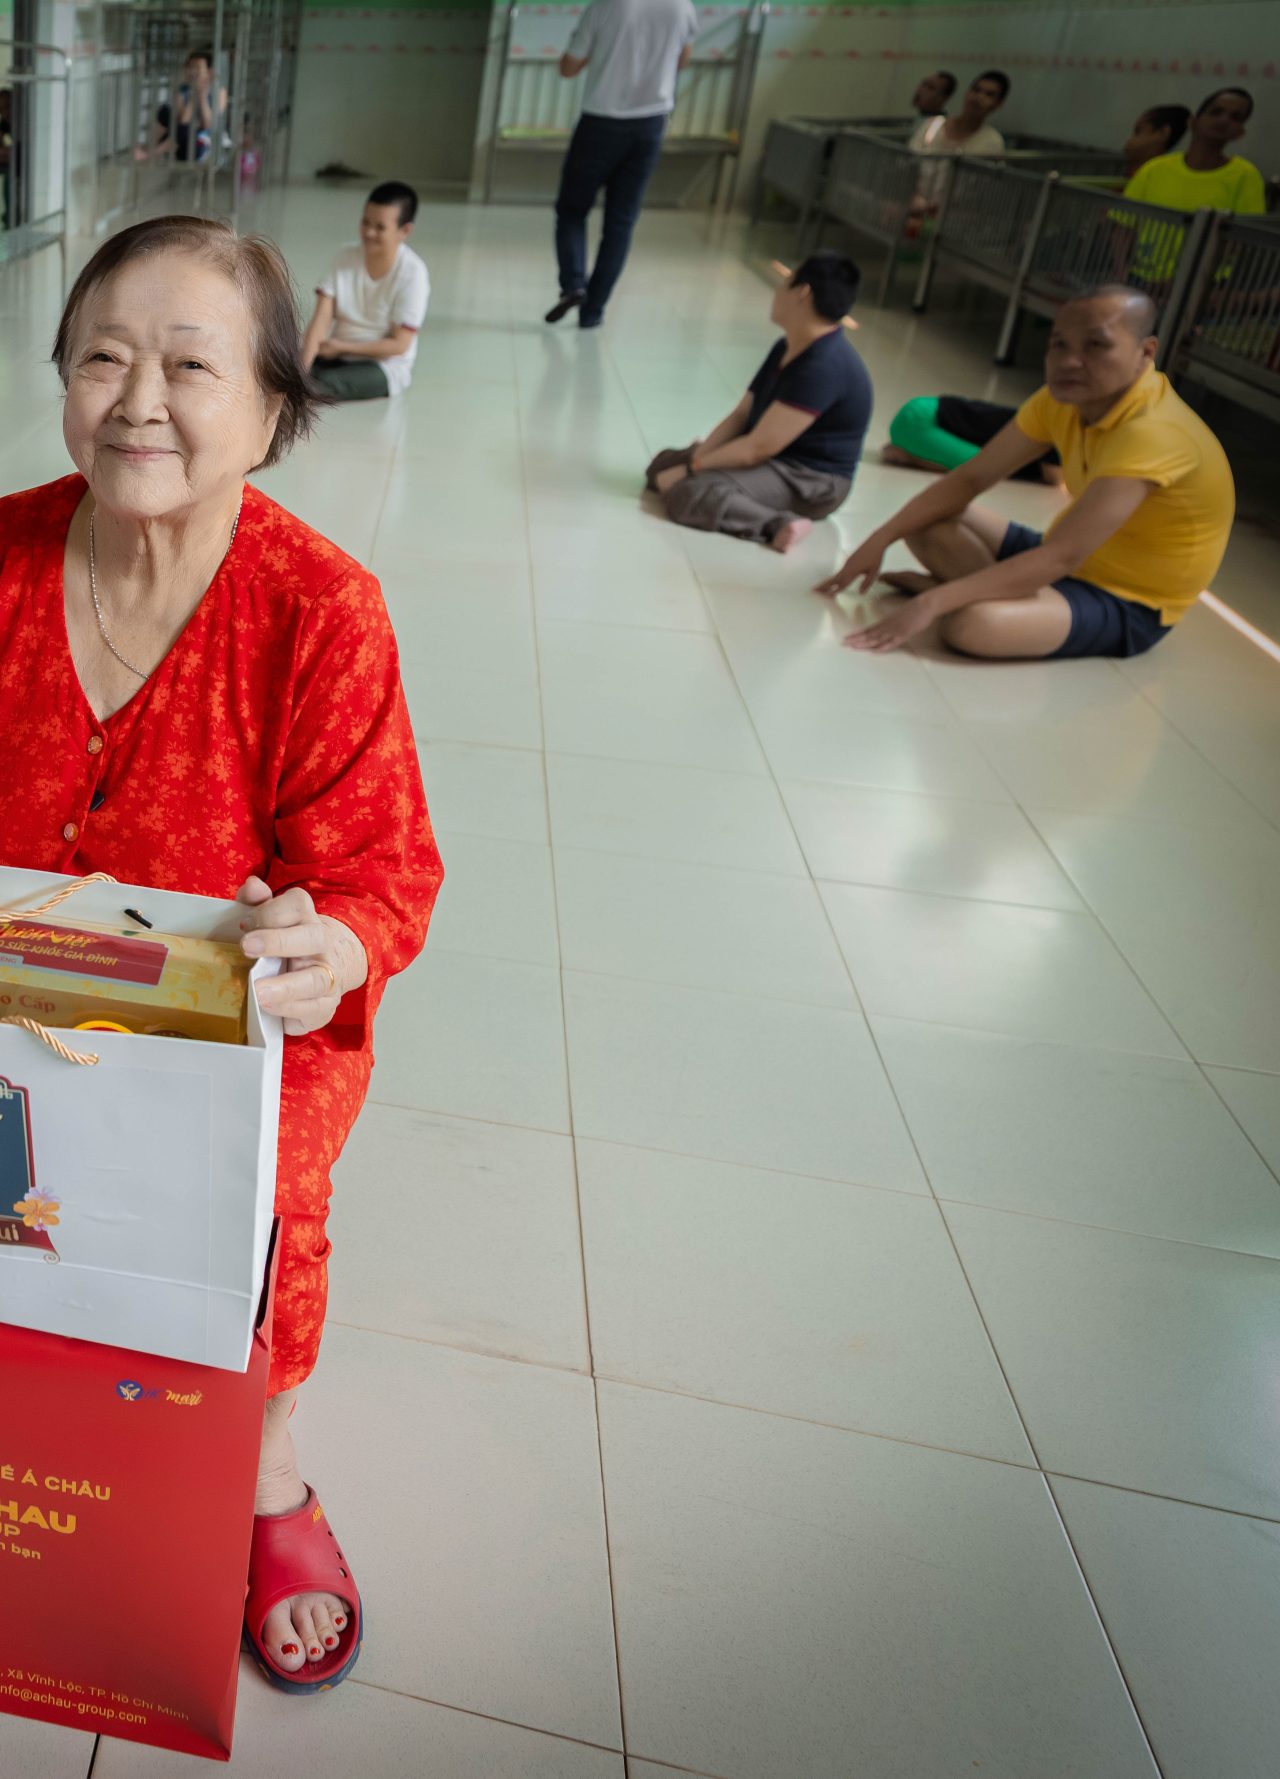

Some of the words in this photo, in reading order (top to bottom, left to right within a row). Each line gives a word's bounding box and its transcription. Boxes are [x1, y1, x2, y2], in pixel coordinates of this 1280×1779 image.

[64, 949, 84, 961] GIA
[20, 994, 57, 1014] Cấp
[21, 1468, 38, 1487] Á
[44, 1476, 111, 1501] CHÂU
[11, 1541, 41, 1560] bạn
[7, 1667, 24, 1680] Xã
[27, 1673, 56, 1688] Vĩnh
[58, 1679, 85, 1695] Lộc,
